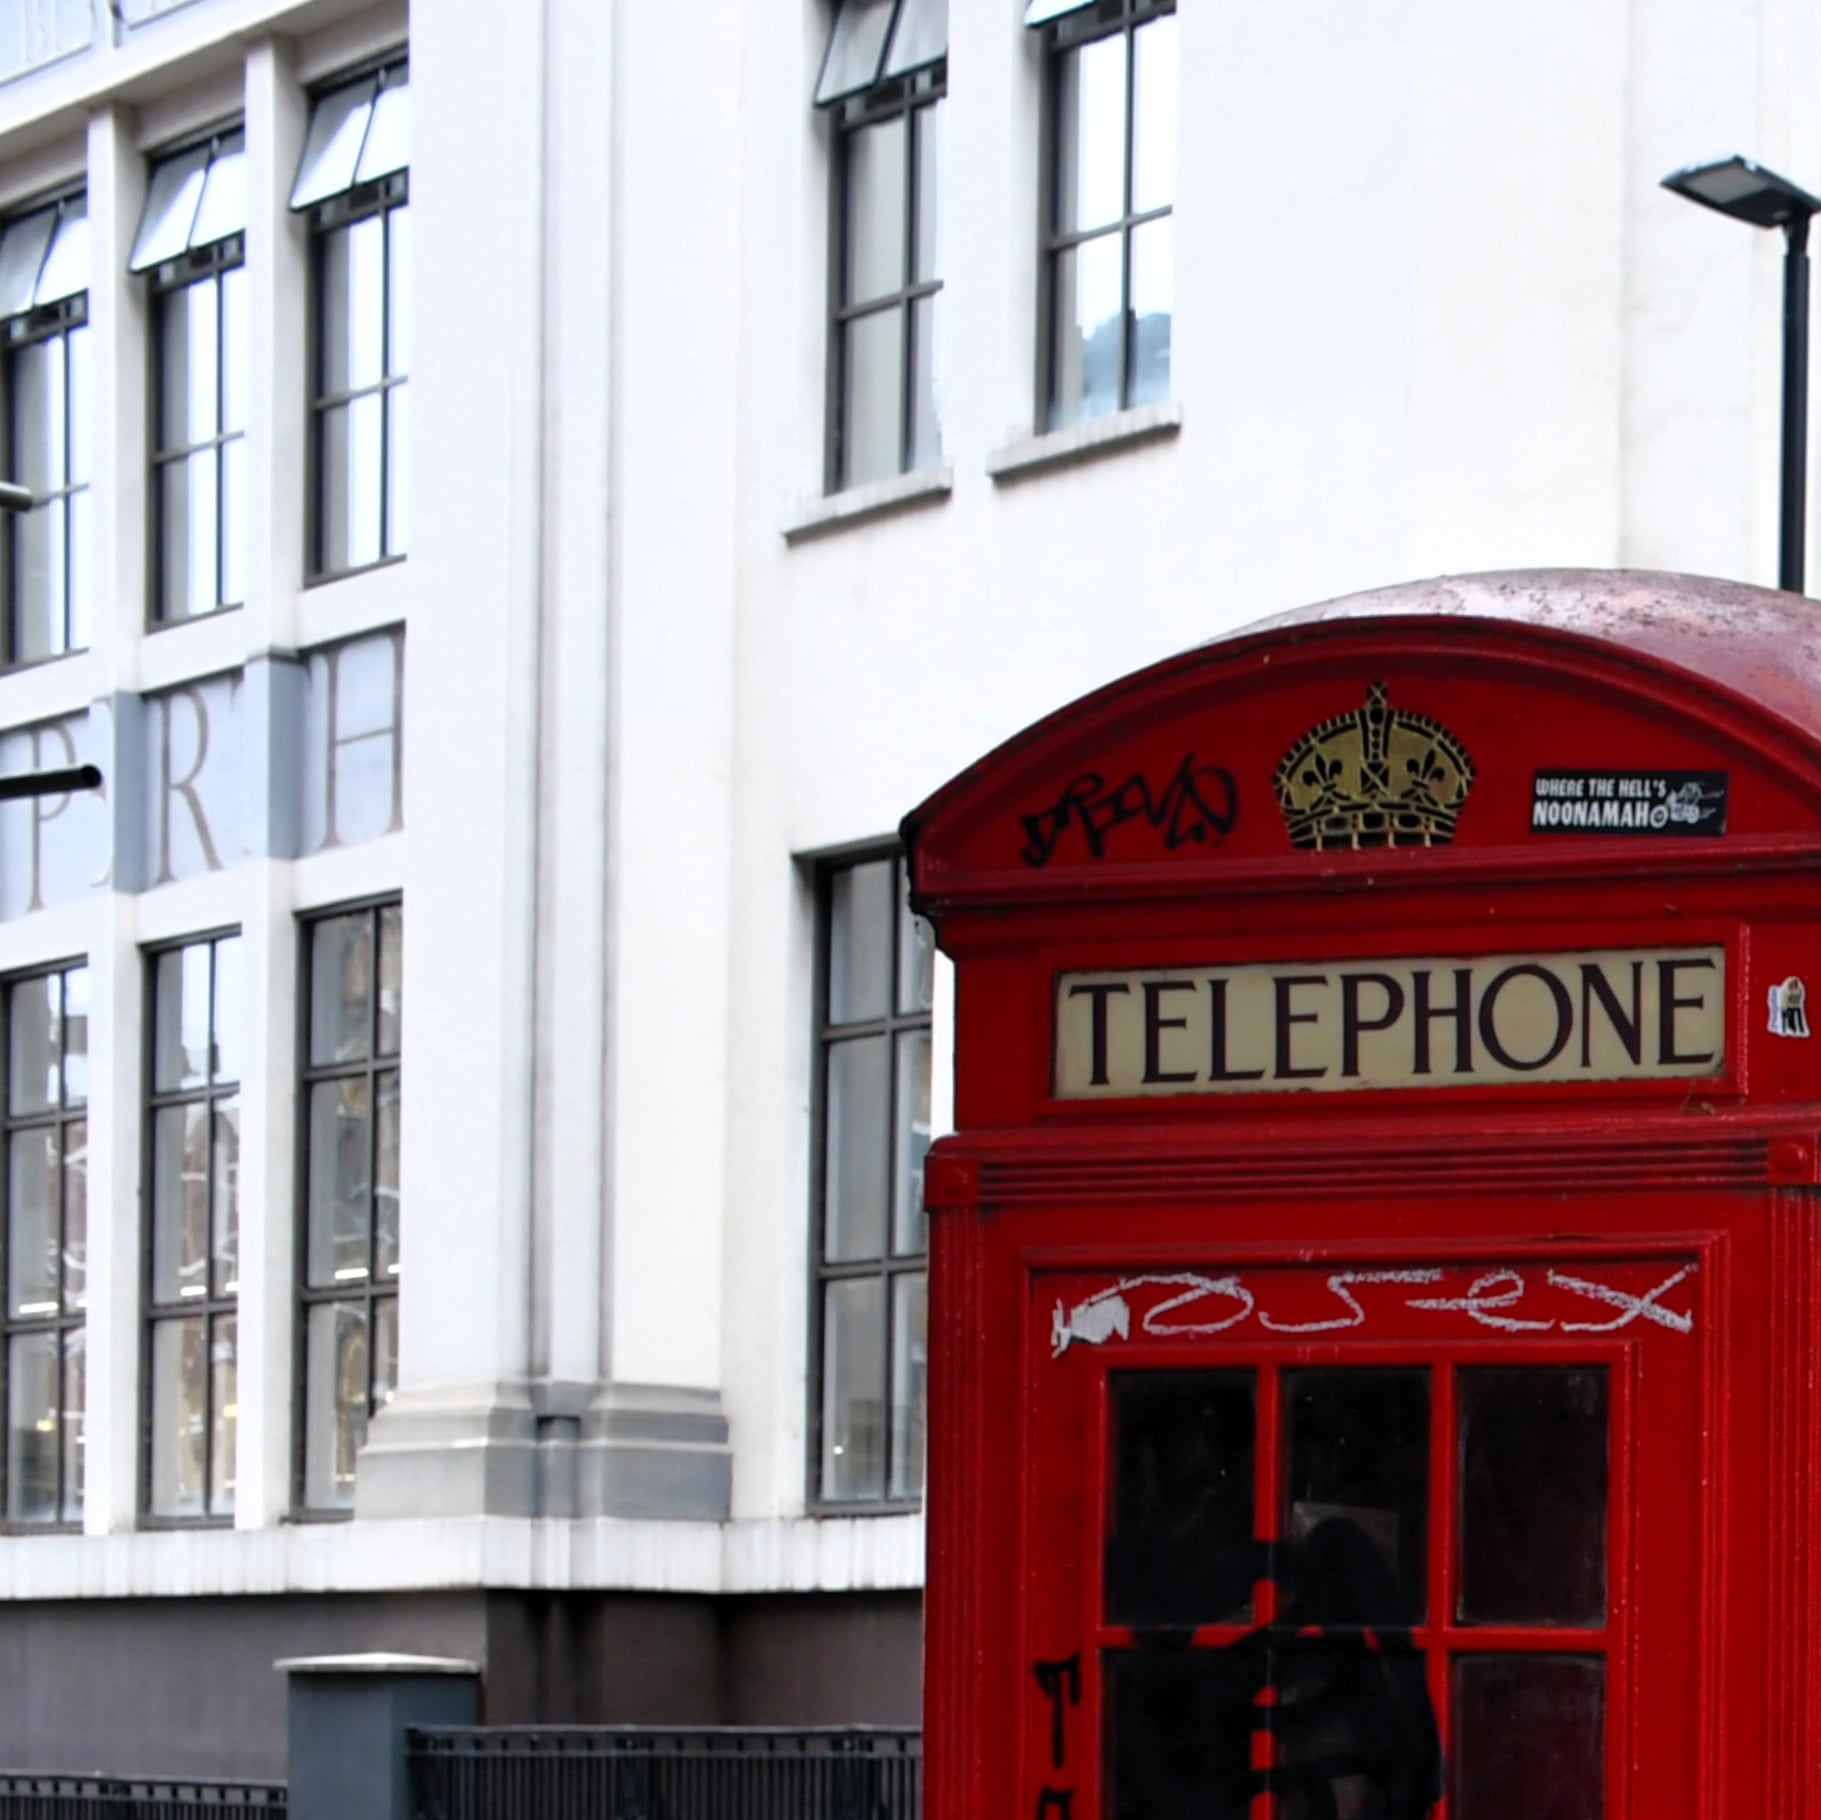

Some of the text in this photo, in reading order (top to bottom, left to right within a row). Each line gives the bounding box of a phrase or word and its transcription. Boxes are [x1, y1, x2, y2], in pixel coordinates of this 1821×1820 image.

[1534, 777, 1667, 798] WHERE THE HELL'S
[1068, 957, 1717, 1087] TELEPHONE
